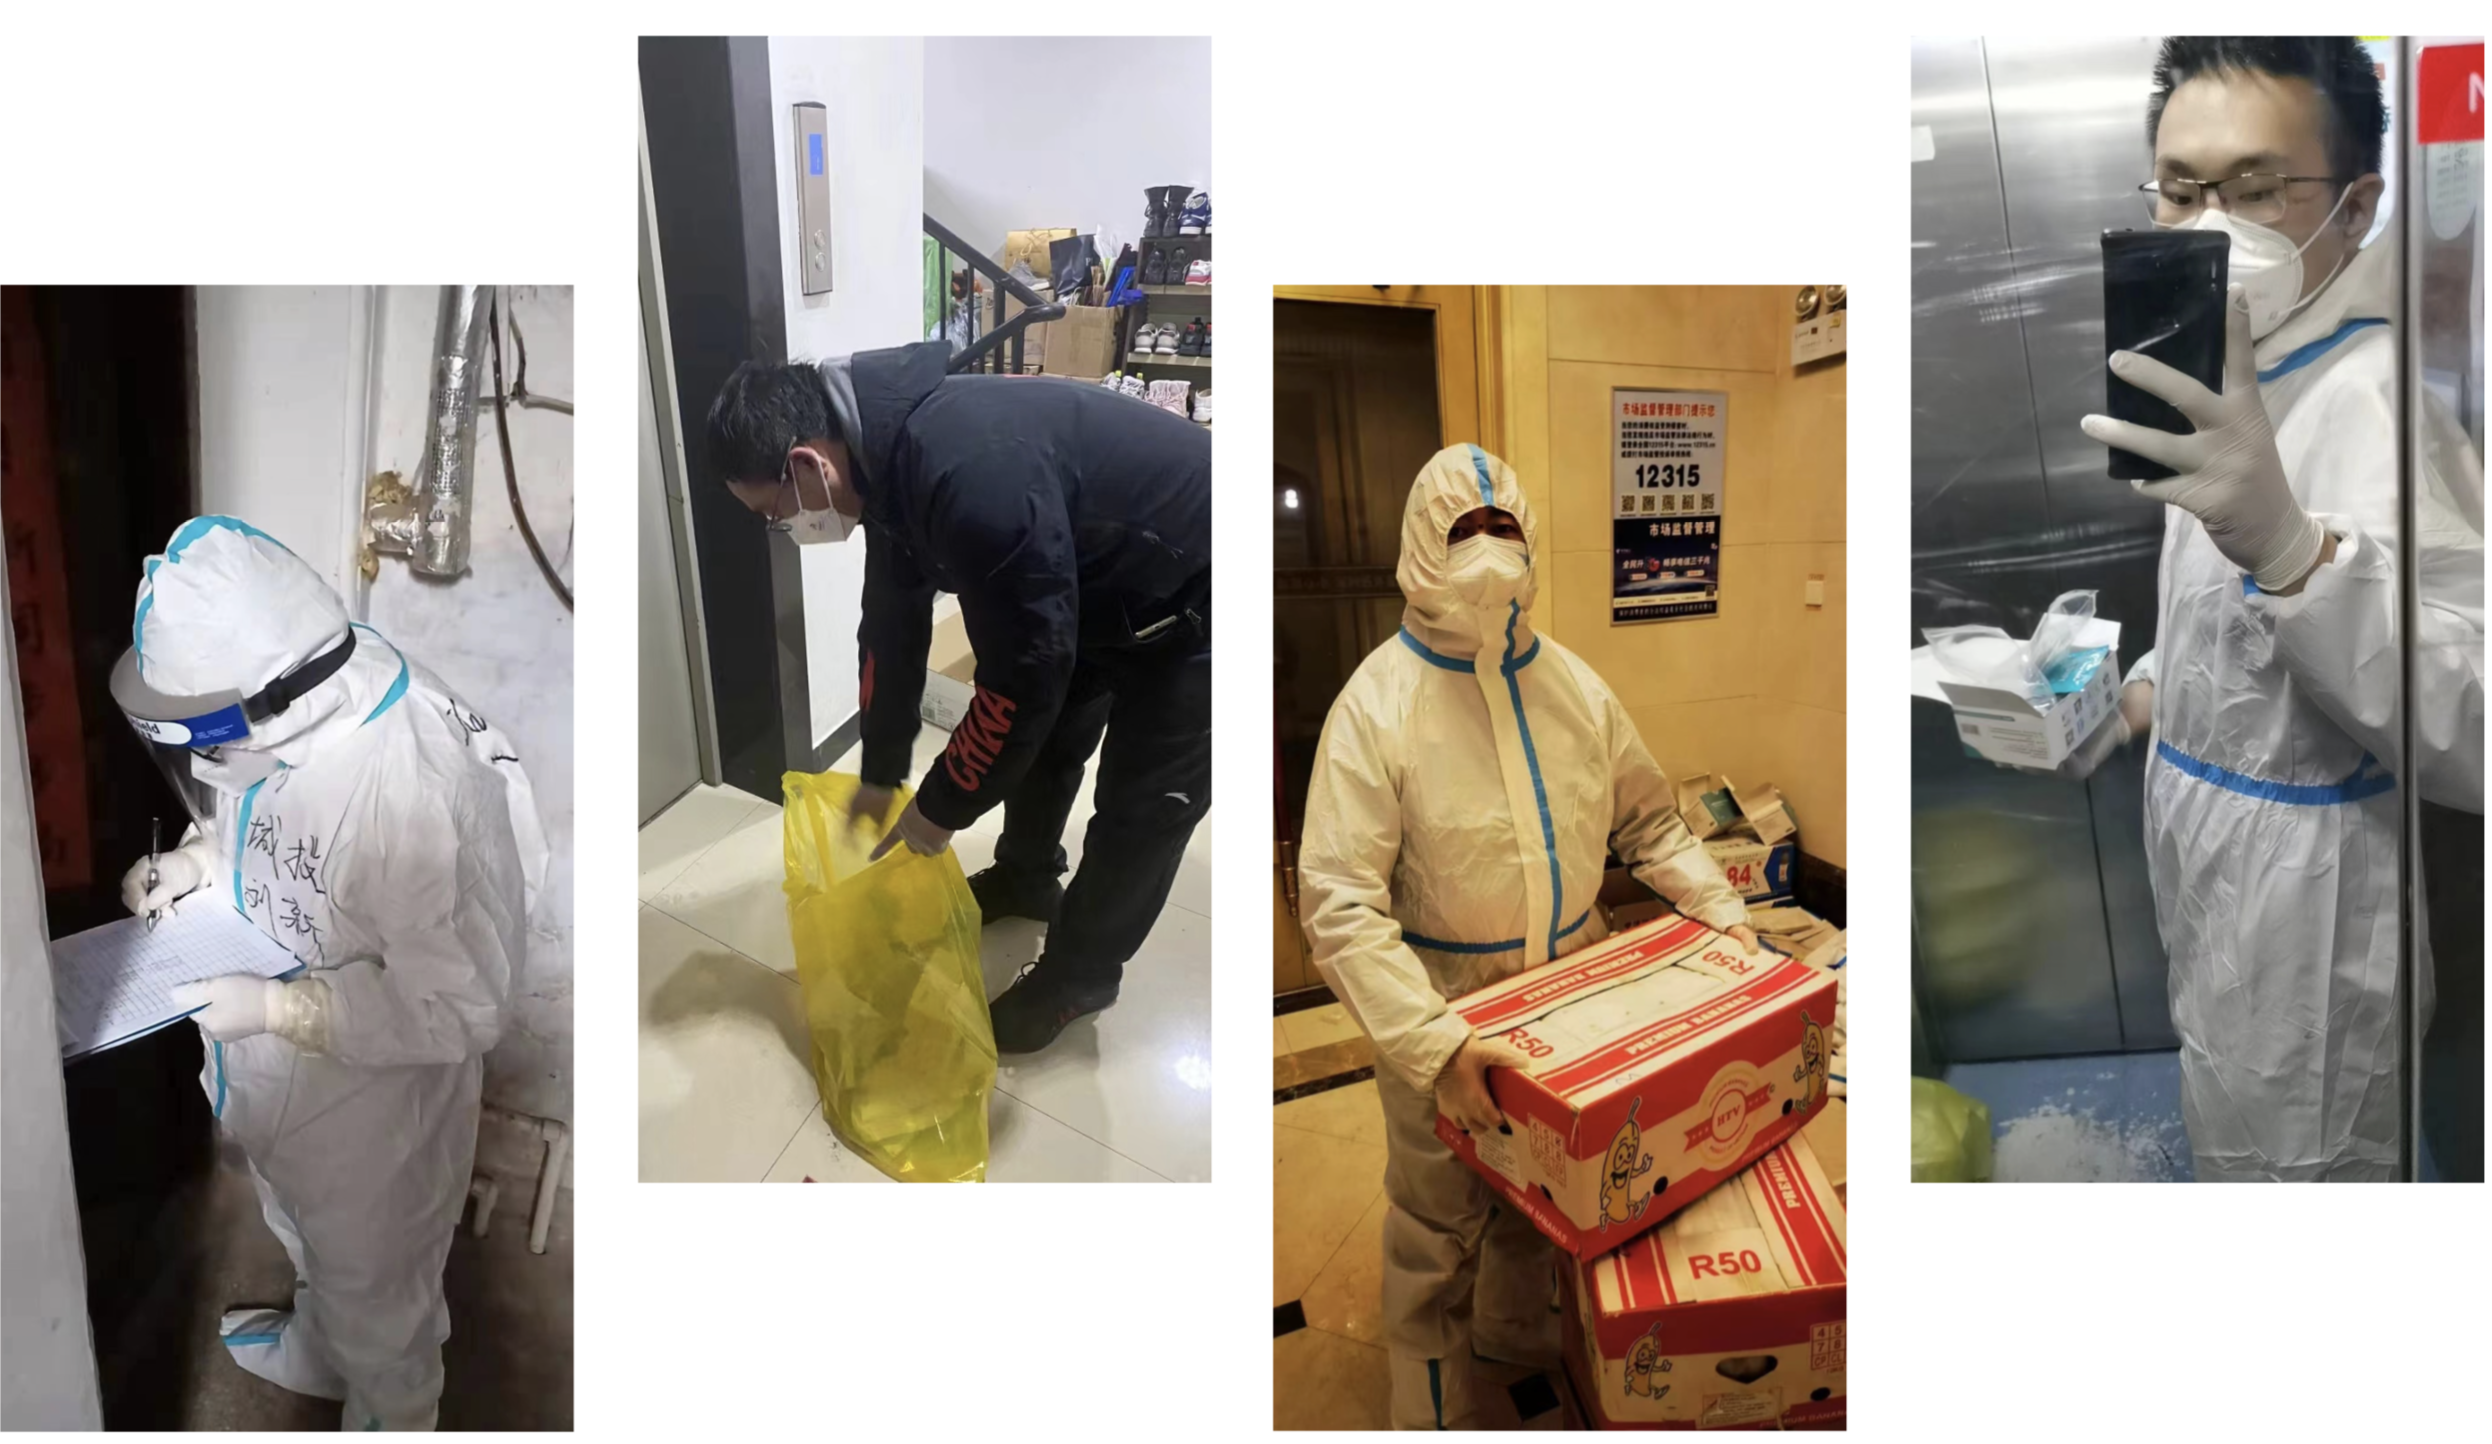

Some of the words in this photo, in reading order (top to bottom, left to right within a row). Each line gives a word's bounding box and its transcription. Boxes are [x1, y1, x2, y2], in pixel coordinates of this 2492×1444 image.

[1622, 403, 1716, 417] 市场监督管理部门提示您
[1636, 464, 1700, 488] 12315
[1649, 521, 1715, 537] 市场监督管理
[945, 684, 1017, 792] CHINA
[1727, 863, 1751, 887] 84
[1702, 950, 1755, 976] R50
[1624, 1021, 1693, 1055] PREMIUM
[1690, 994, 1753, 1025] BANANAS
[1500, 1027, 1554, 1059] R50
[1716, 1104, 1741, 1127] HTV
[1533, 1209, 1568, 1244] BANANAS
[1688, 1249, 1762, 1280] R50
[1817, 1327, 1825, 1338] 4
[1834, 1324, 1843, 1336] 5
[1817, 1341, 1825, 1352] 7
[1833, 1338, 1842, 1350] 8
[1814, 1355, 1827, 1367] CP
[1830, 1352, 1843, 1364] CL
